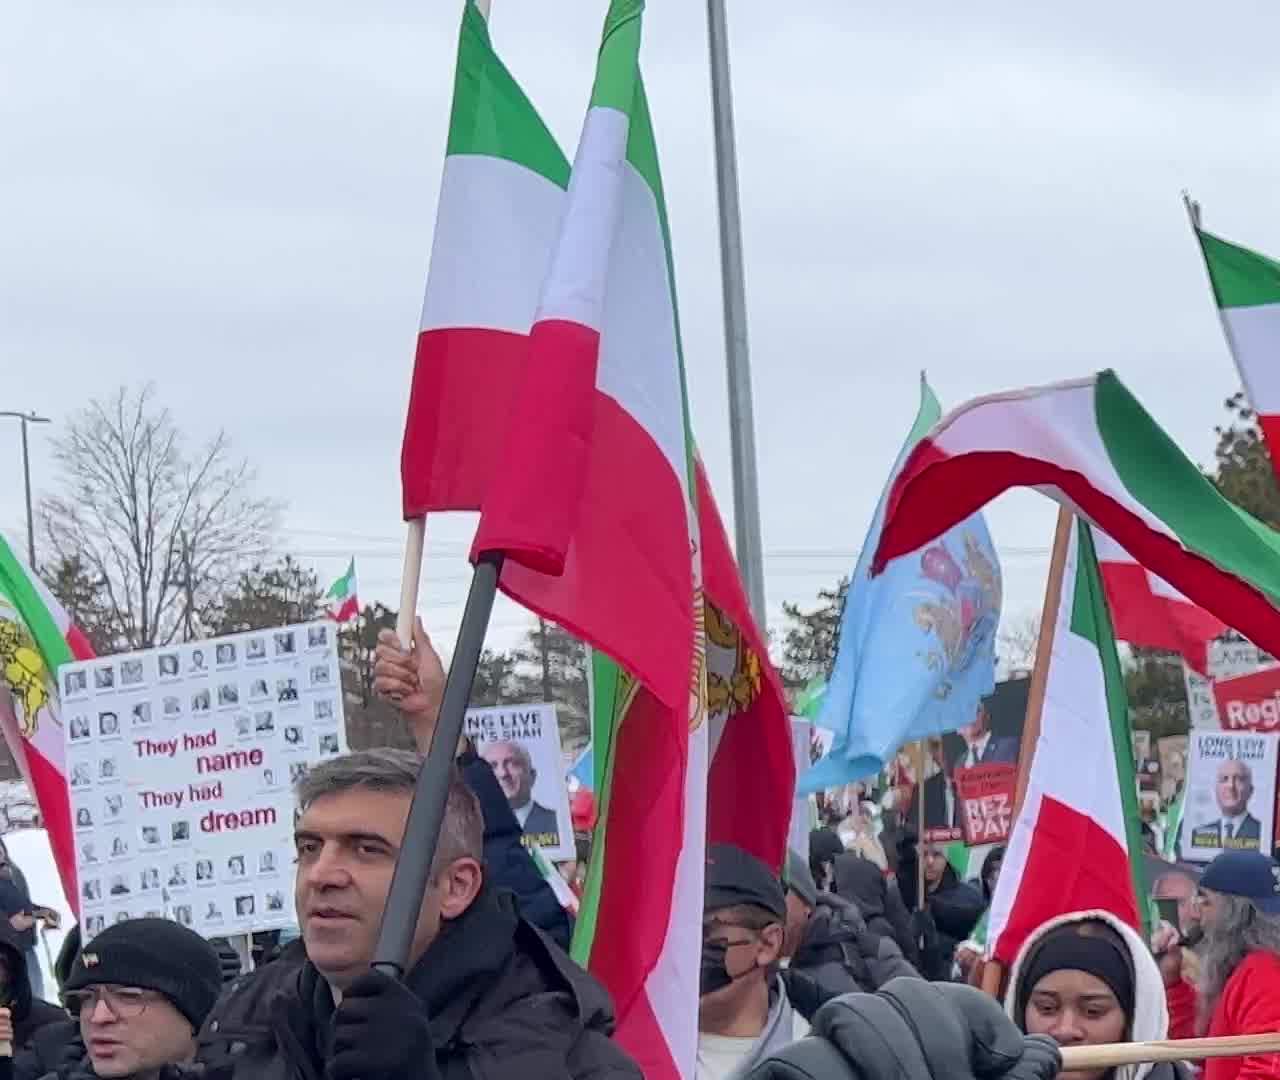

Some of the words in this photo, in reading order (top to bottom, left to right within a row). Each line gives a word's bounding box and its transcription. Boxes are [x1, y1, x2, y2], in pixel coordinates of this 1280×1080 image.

[500, 712, 542, 727] LIVE
[134, 738, 178, 758] They
[184, 728, 217, 751] had
[197, 748, 263, 774] name
[138, 791, 184, 809] They
[189, 780, 222, 801] had
[200, 806, 276, 833] dream
